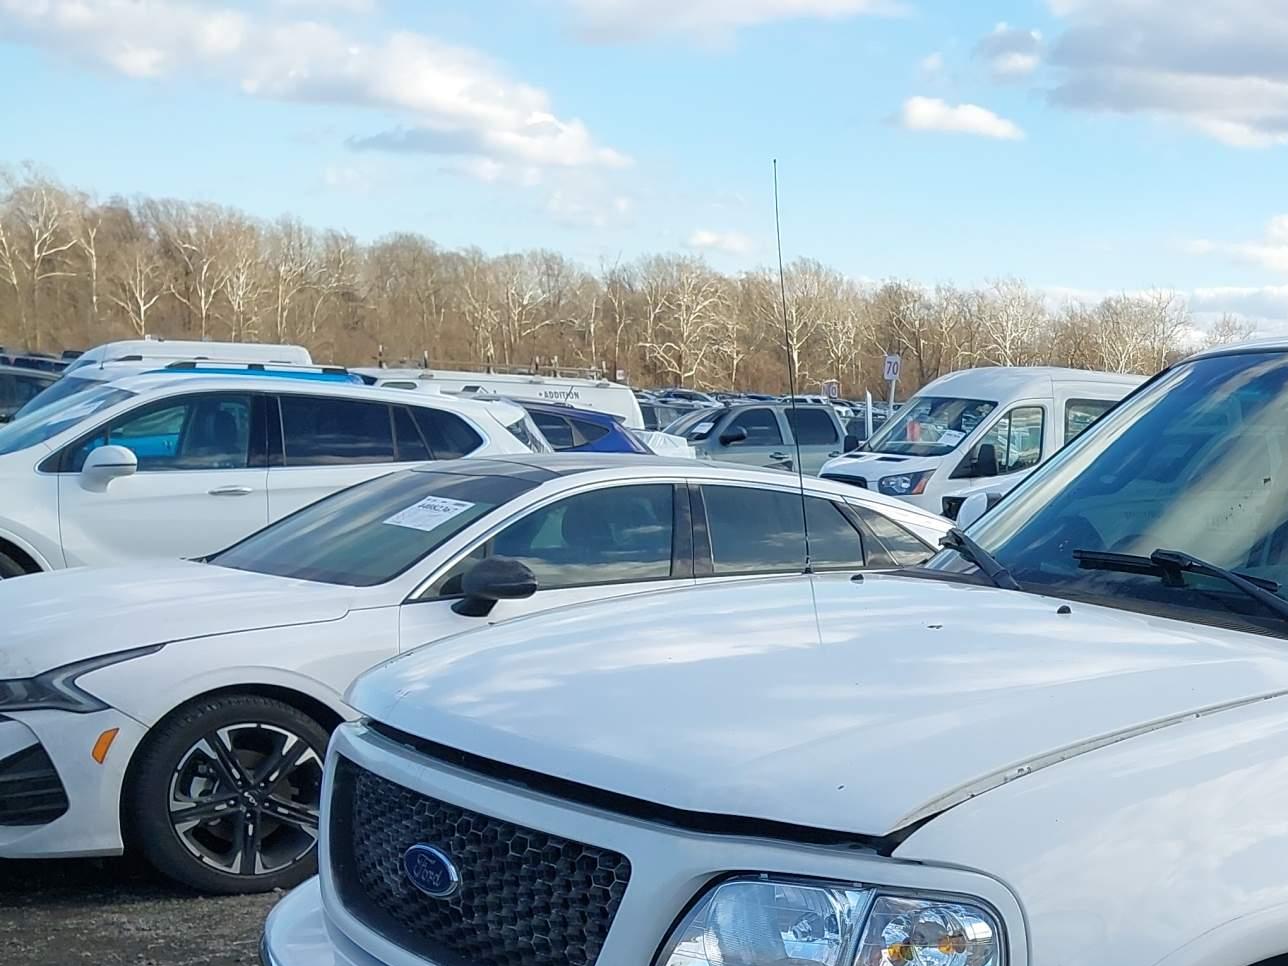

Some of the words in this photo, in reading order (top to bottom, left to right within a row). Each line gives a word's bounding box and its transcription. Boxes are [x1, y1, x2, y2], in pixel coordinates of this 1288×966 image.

[886, 360, 899, 375] 70
[544, 391, 580, 399] ADDITION
[412, 853, 444, 888] Ford
